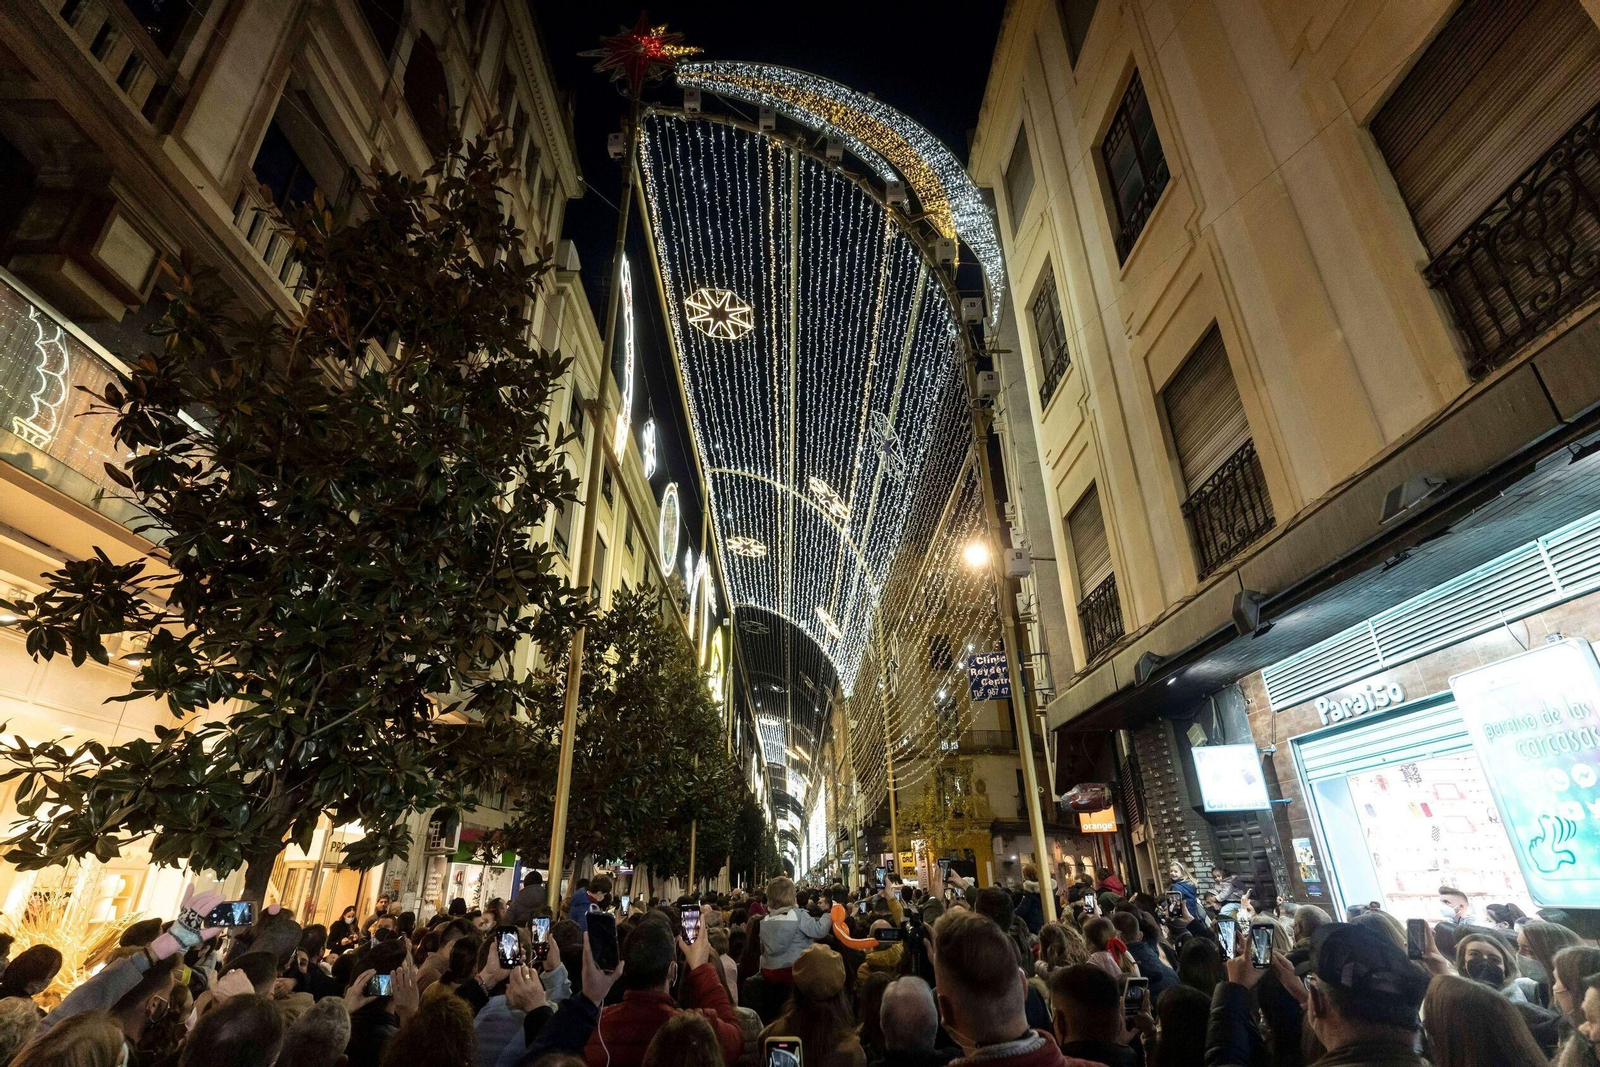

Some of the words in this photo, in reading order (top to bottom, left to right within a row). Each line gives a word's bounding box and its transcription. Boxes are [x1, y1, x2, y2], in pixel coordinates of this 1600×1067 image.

[1314, 682, 1406, 726] Paraiso
[1540, 700, 1562, 727] de
[1561, 694, 1591, 720] las
[1083, 822, 1113, 831] orange
